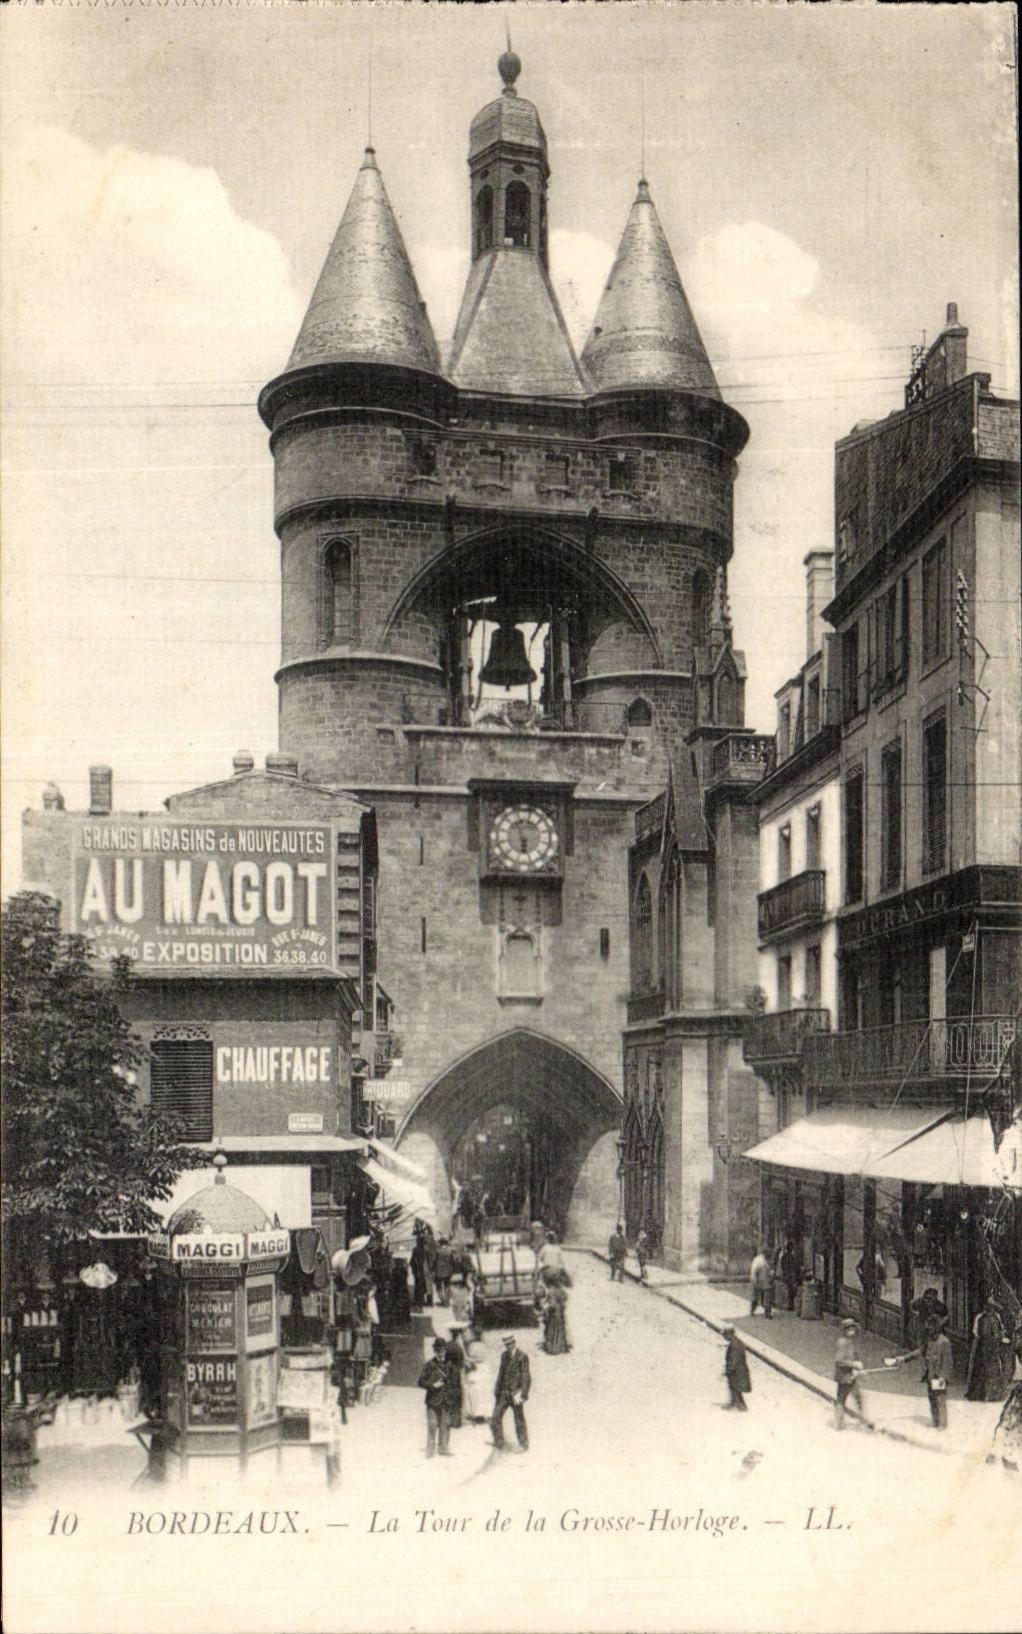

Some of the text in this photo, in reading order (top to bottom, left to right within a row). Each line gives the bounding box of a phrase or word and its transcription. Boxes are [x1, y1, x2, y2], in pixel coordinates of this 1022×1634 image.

[82, 826, 137, 850] GRANDS
[142, 828, 215, 852] MAGASINS
[219, 834, 236, 853] de
[80, 857, 328, 926] AU MAGOT
[856, 890, 945, 936] DURAND
[142, 941, 269, 964] EXPOSITION
[216, 1045, 331, 1083] CHAUFFAGE
[177, 1242, 240, 1258] MAGGI
[250, 1238, 288, 1256] MAGGI
[187, 1363, 237, 1382] BYRRH
